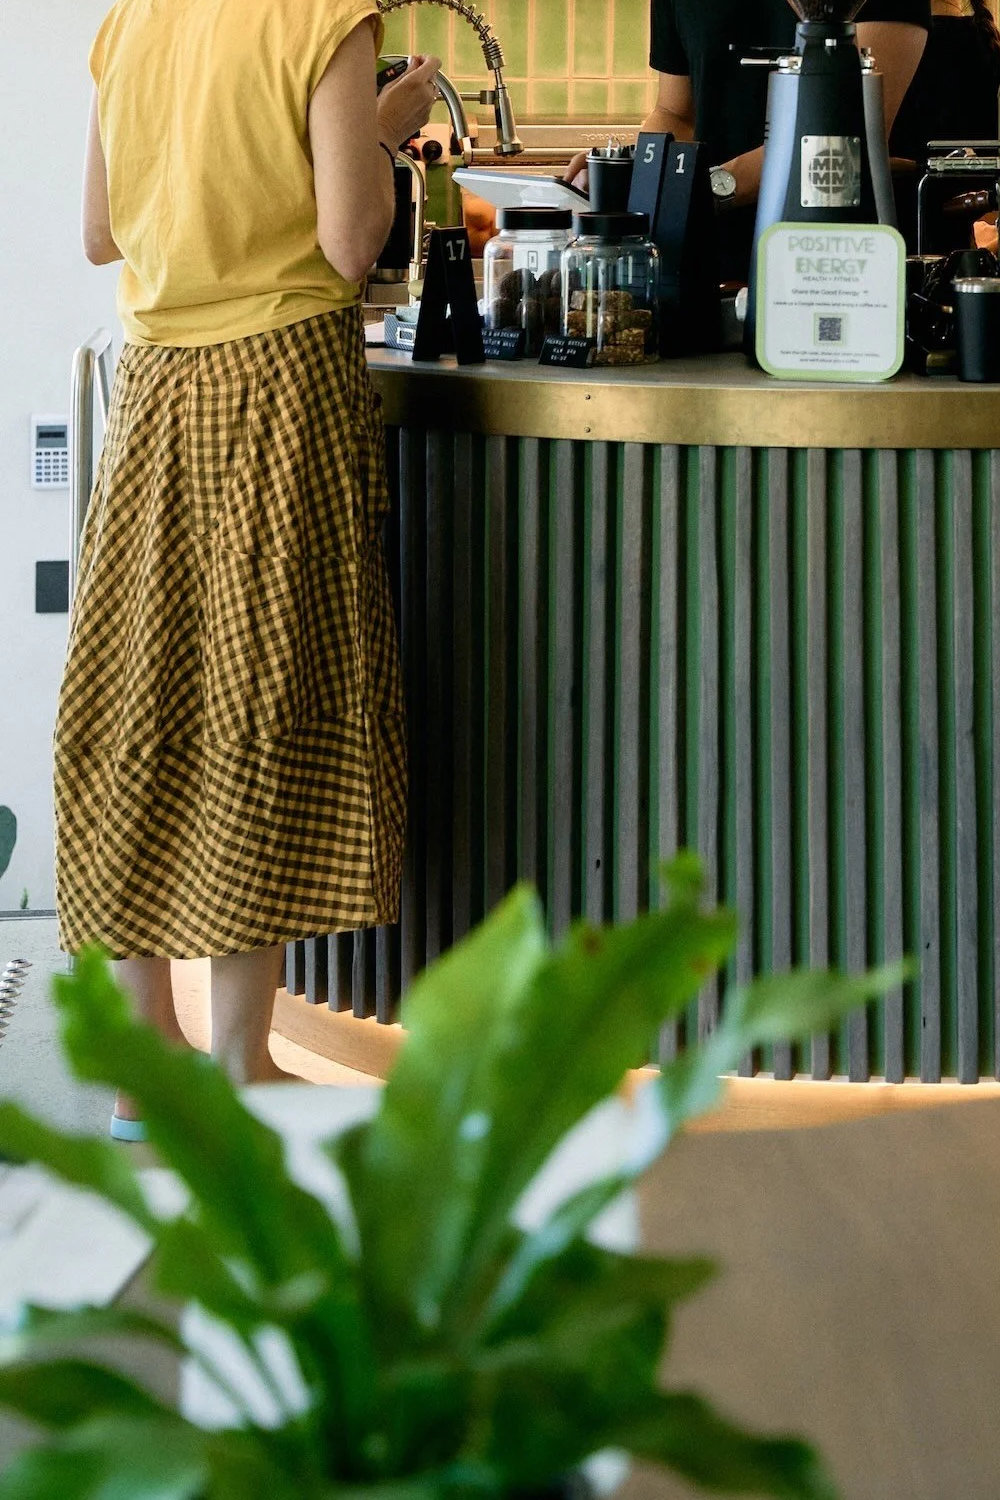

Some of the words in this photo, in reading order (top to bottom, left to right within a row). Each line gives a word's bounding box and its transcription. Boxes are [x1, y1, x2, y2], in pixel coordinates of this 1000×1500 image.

[643, 143, 654, 163] 5
[675, 152, 684, 174] 1
[446, 240, 465, 261] 17
[788, 236, 876, 253] POSITIVE
[795, 257, 868, 274] ENERGY
